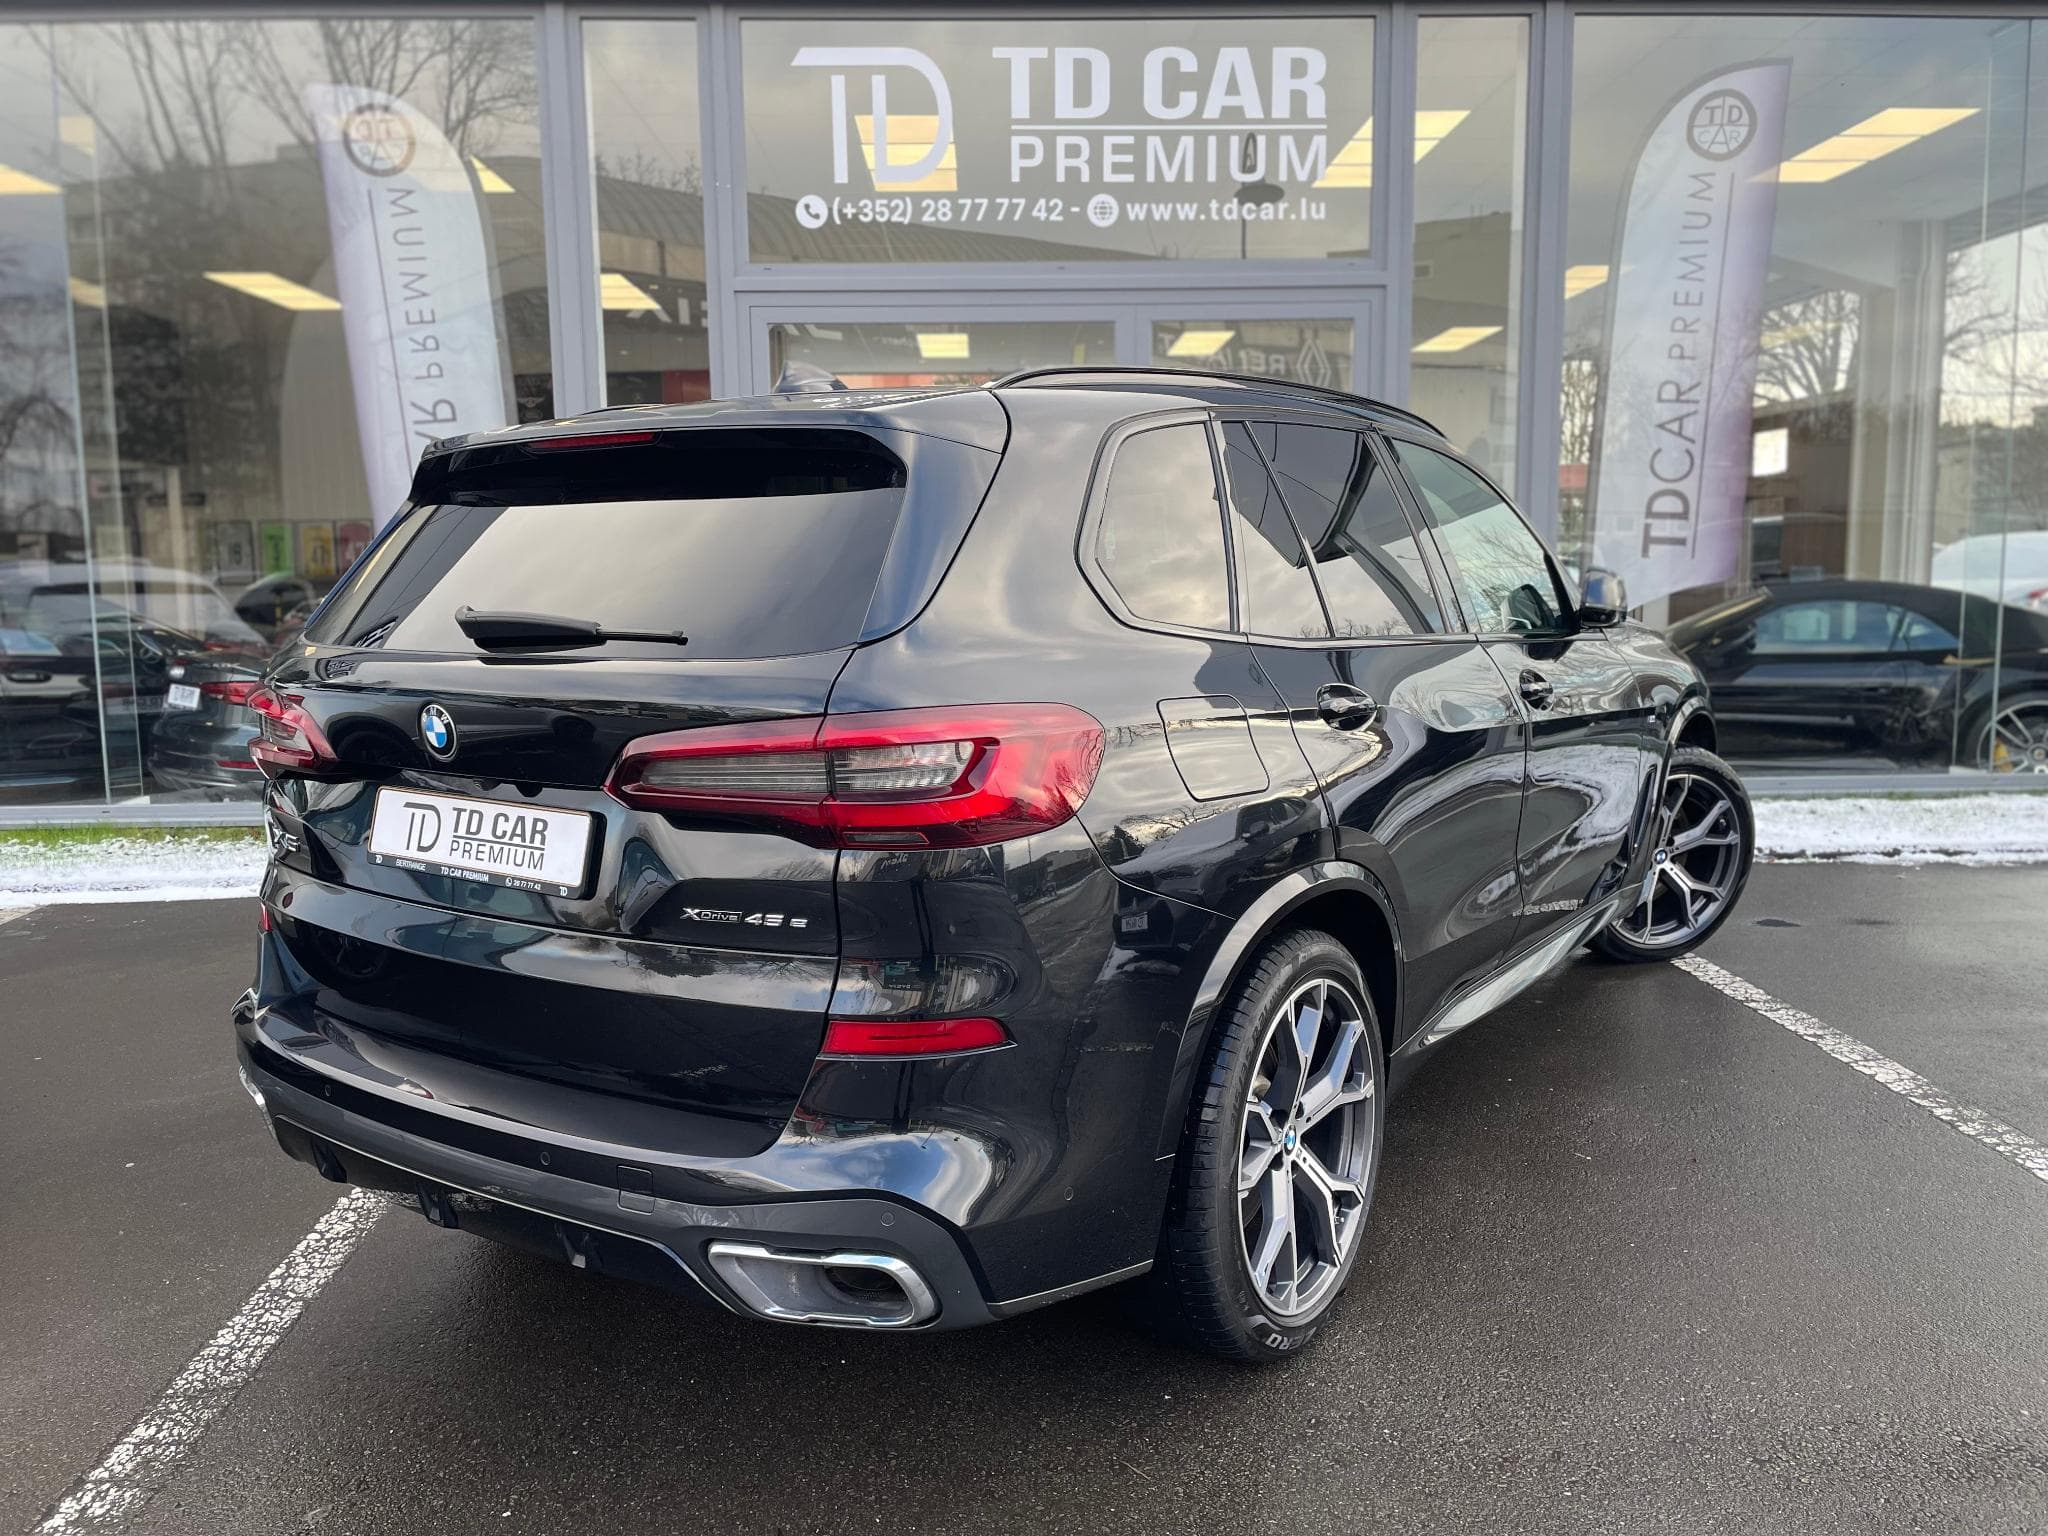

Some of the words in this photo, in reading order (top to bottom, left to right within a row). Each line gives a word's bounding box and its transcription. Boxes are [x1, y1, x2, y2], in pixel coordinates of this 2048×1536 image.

[992, 46, 1111, 120] TD
[1143, 46, 1328, 120] CAR
[1704, 104, 1743, 125] TD
[1010, 134, 1328, 184] PREMIUM
[832, 196, 913, 225] (+352)
[921, 199, 953, 222] 28
[958, 199, 989, 222] 77
[995, 199, 1026, 222] 77
[1032, 199, 1064, 222] 42
[1126, 198, 1327, 222] www.tdcar.lu
[1668, 171, 1717, 361] PREMIUM
[452, 806, 484, 836] TD
[491, 812, 549, 847] CAR
[449, 839, 545, 872] PREMIUM
[440, 866, 449, 875] TD
[450, 867, 462, 878] CAR
[462, 869, 489, 883] PREMIUM
[744, 913, 785, 927] 45
